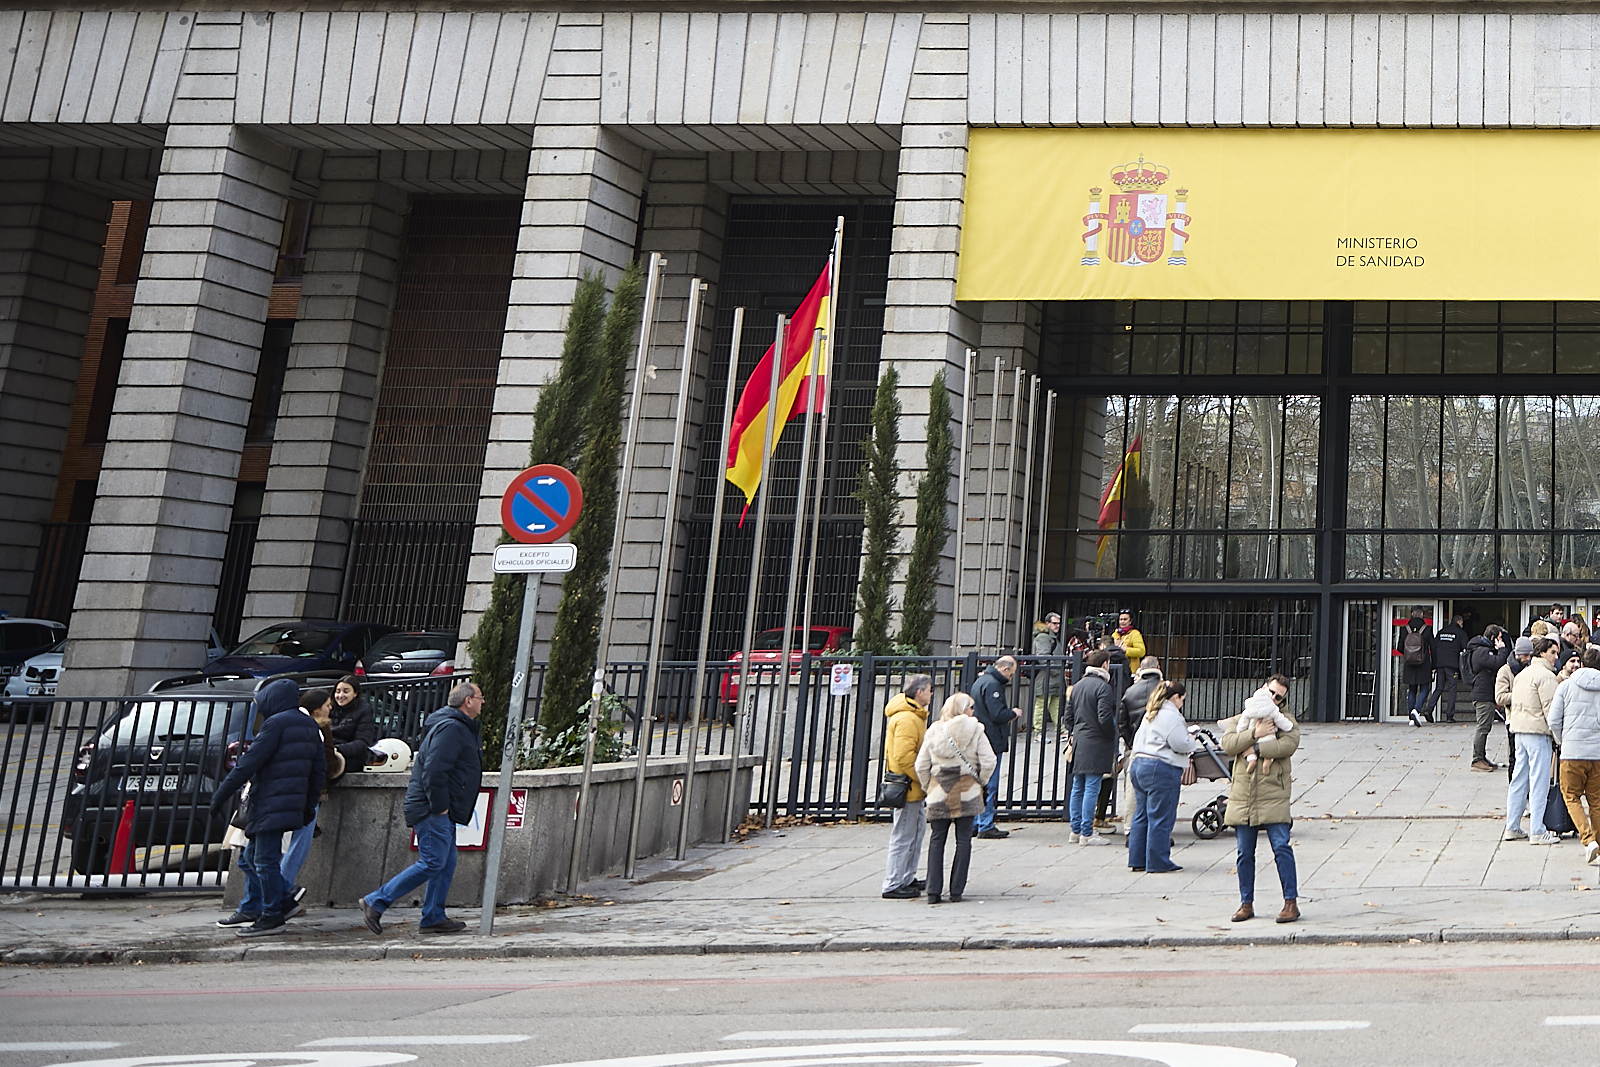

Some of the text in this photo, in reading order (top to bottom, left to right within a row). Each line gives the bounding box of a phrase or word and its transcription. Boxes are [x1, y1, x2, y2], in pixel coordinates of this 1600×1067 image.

[1337, 237, 1418, 249] MINISTERIO
[1336, 255, 1425, 267] DE SANIDAD
